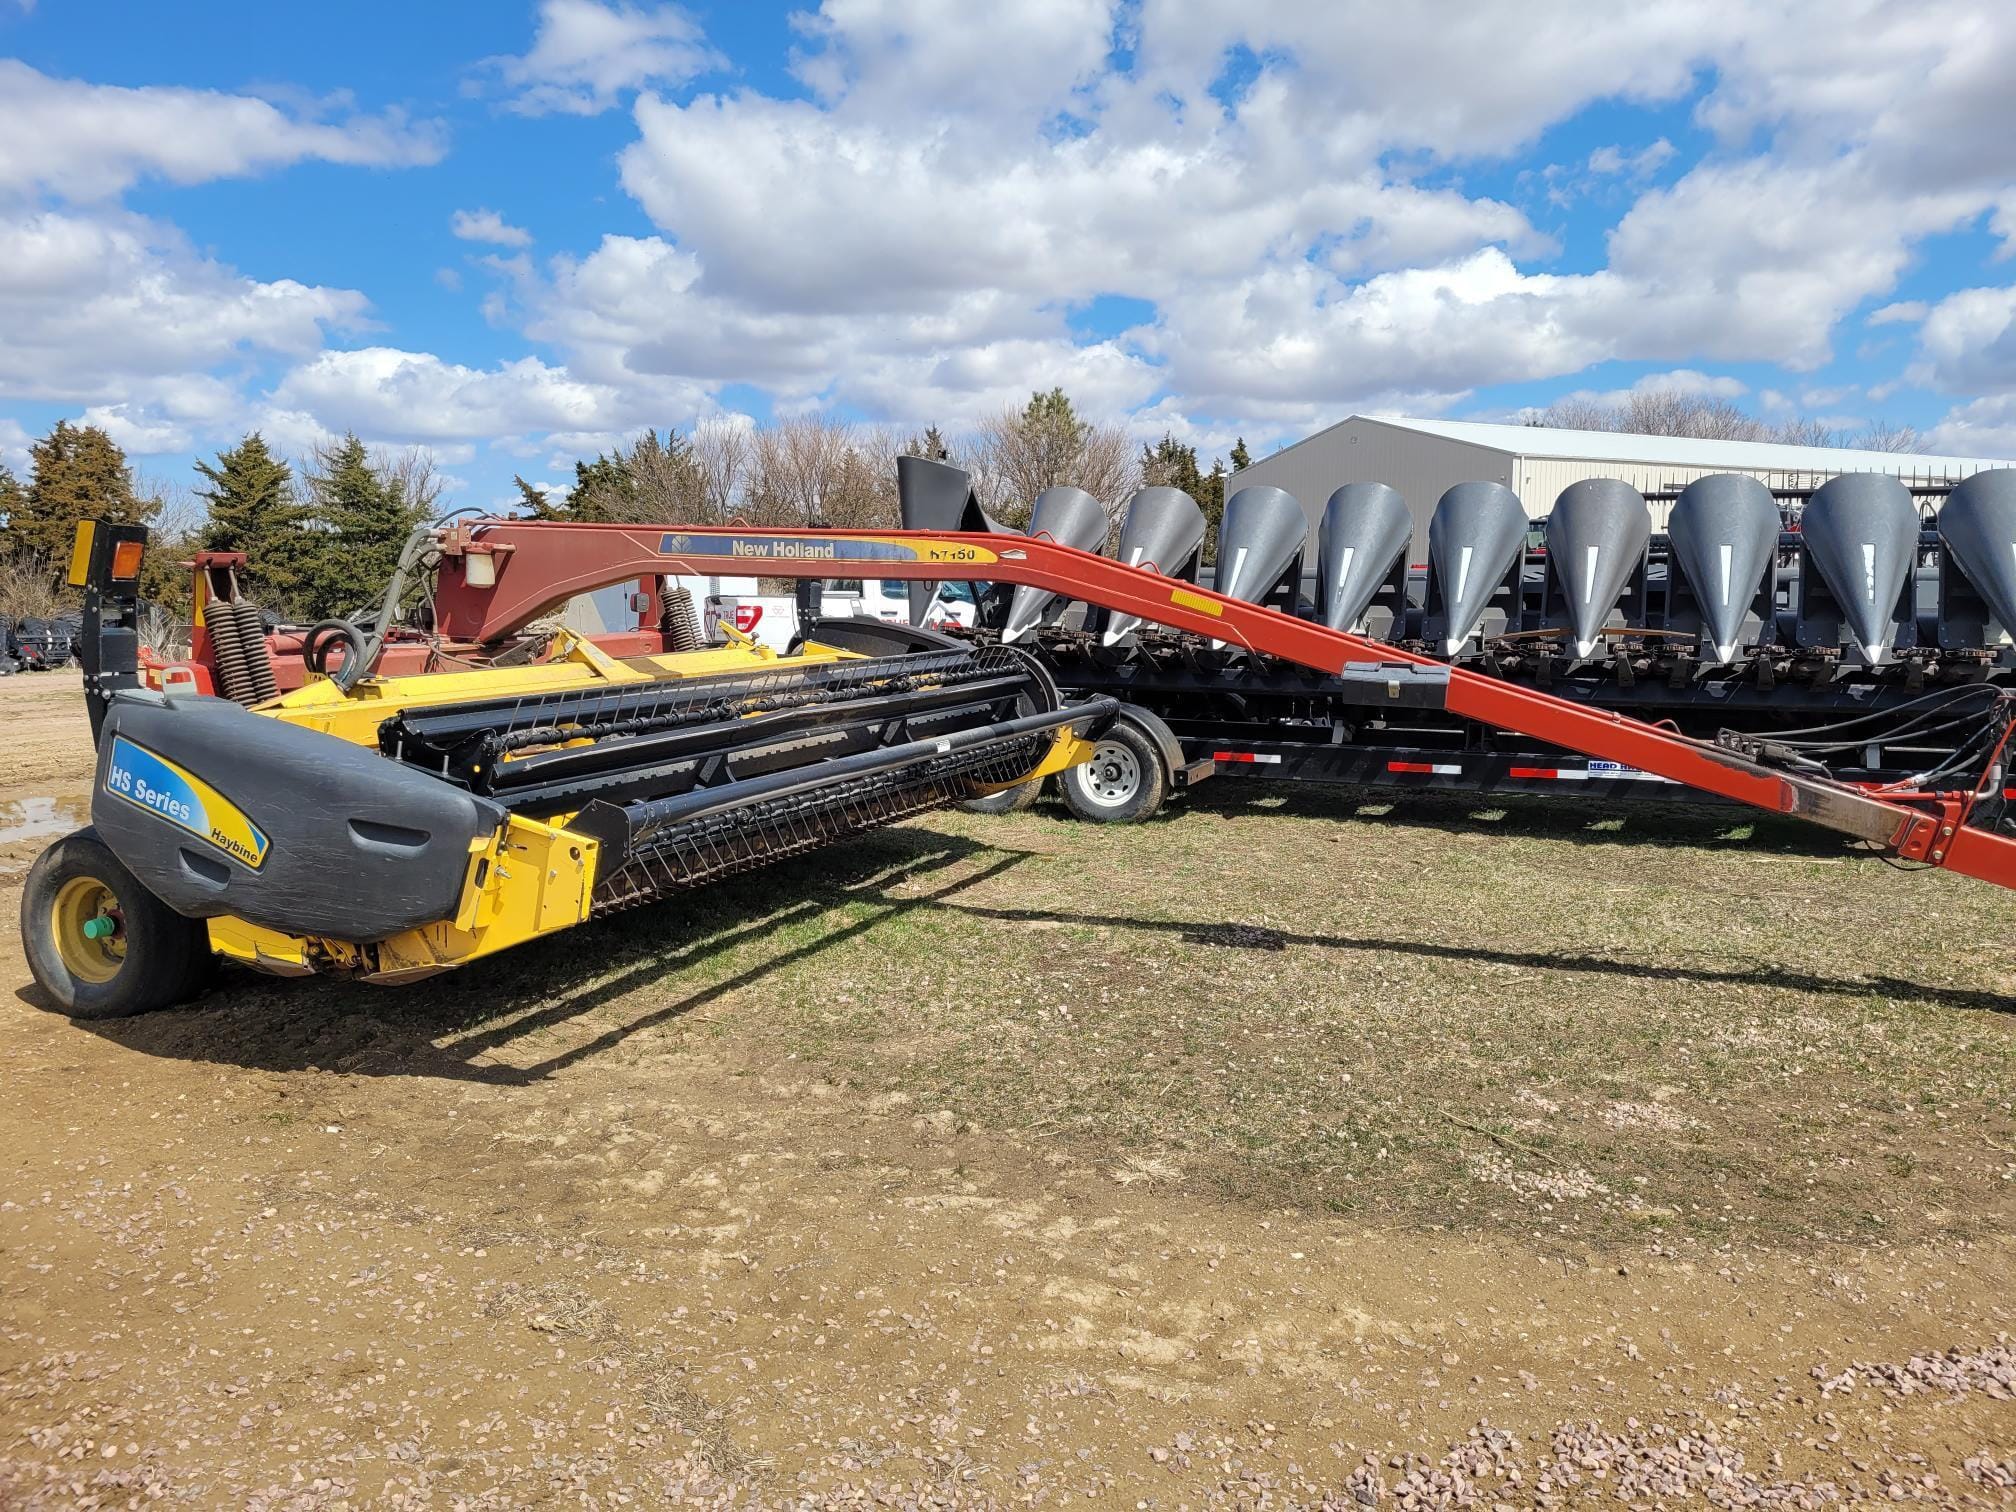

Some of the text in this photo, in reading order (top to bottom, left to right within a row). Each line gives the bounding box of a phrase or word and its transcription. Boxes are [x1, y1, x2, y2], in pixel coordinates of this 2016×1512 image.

[732, 540, 834, 558] New Holland
[110, 765, 191, 821] HS Series
[211, 827, 258, 863] Haybine
